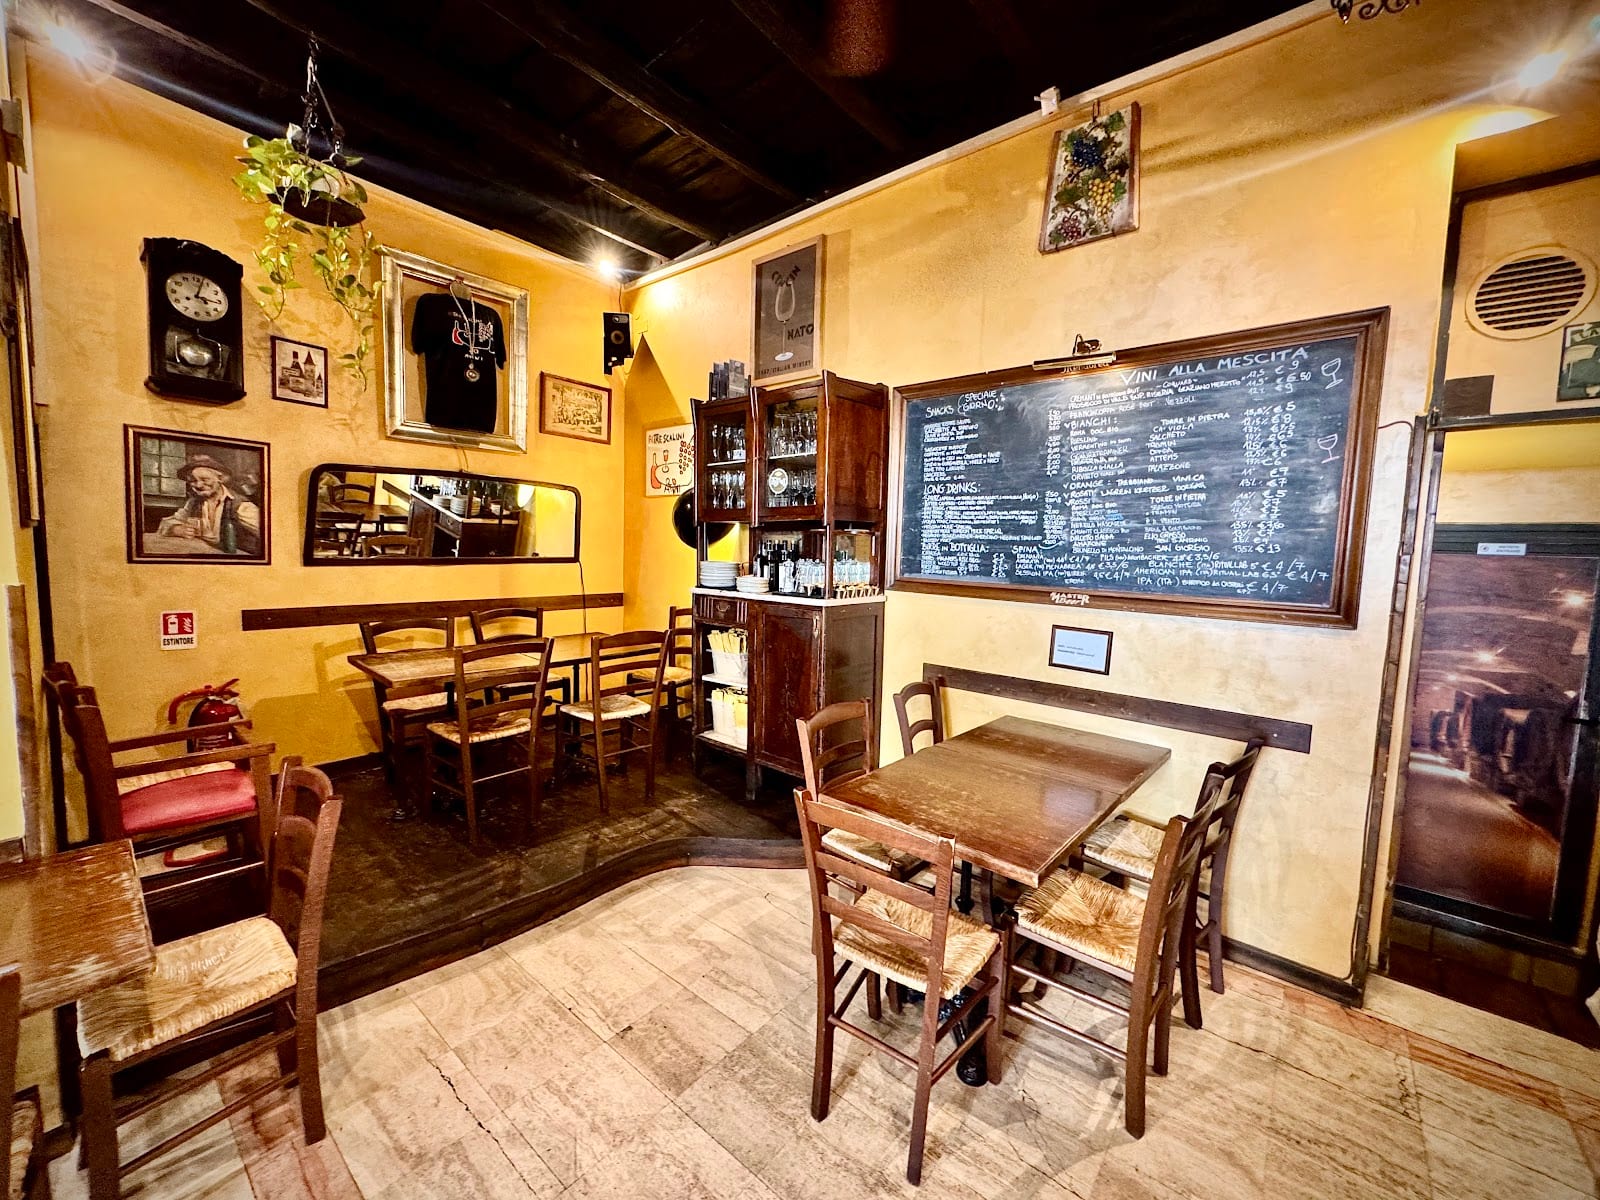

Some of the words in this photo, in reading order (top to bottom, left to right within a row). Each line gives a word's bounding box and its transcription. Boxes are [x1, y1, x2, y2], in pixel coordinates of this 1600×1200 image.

[787, 324, 814, 340] NATO
[1120, 369, 1157, 385] VINI
[1169, 362, 1206, 377] ALLA
[163, 637, 195, 646] ESTINTORE
